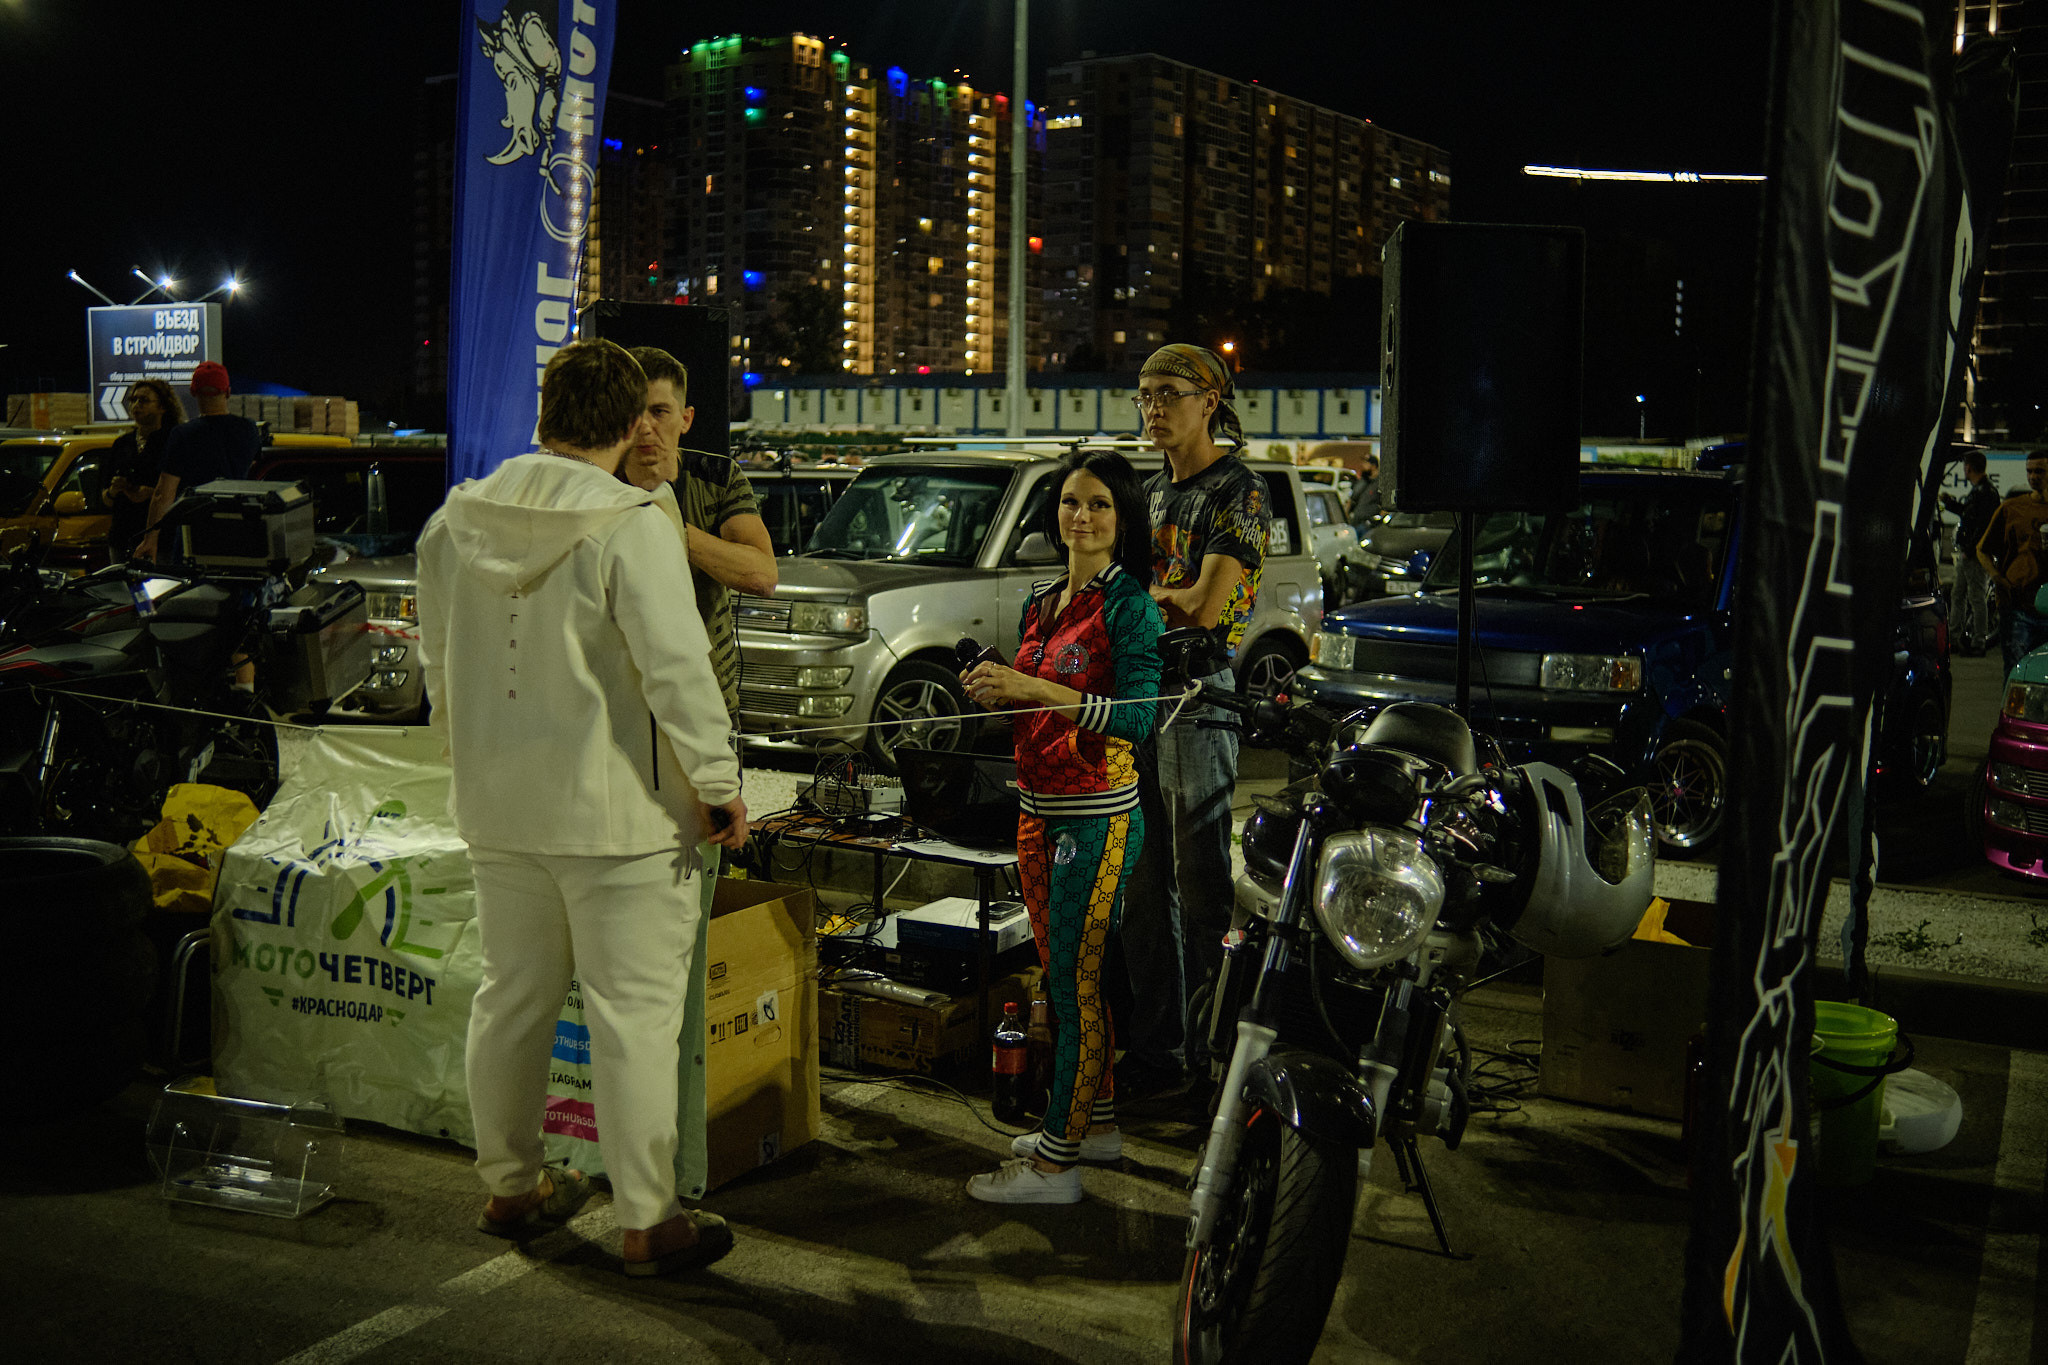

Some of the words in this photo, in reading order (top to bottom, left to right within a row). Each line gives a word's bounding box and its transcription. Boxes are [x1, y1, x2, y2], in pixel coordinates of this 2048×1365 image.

[155, 309, 200, 332] ВЪЕЗД
[113, 337, 122, 356] В
[125, 331, 200, 358] СТРОЙДВОР
[231, 940, 436, 1005] МОТОЧЕТВЕРГ
[292, 996, 383, 1022] #КРАСНОДАР
[549, 1072, 592, 1089] TAGRAM
[544, 1110, 597, 1129] TOTHURSD
